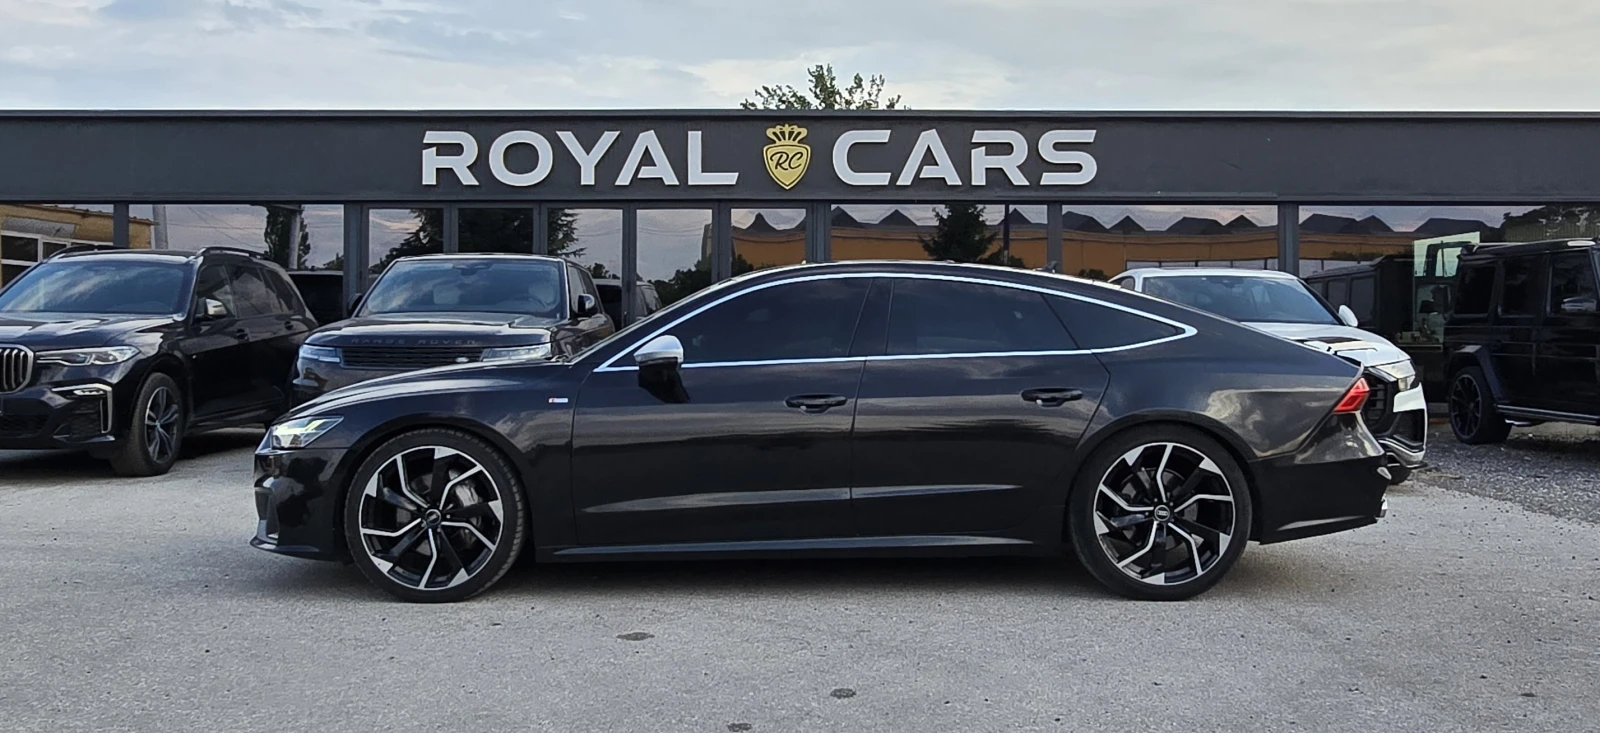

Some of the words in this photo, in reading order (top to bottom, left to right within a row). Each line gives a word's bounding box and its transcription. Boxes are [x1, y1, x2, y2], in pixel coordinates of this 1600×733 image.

[422, 129, 739, 187] ROYAL
[832, 128, 1098, 186] CARS
[770, 151, 804, 171] RC
